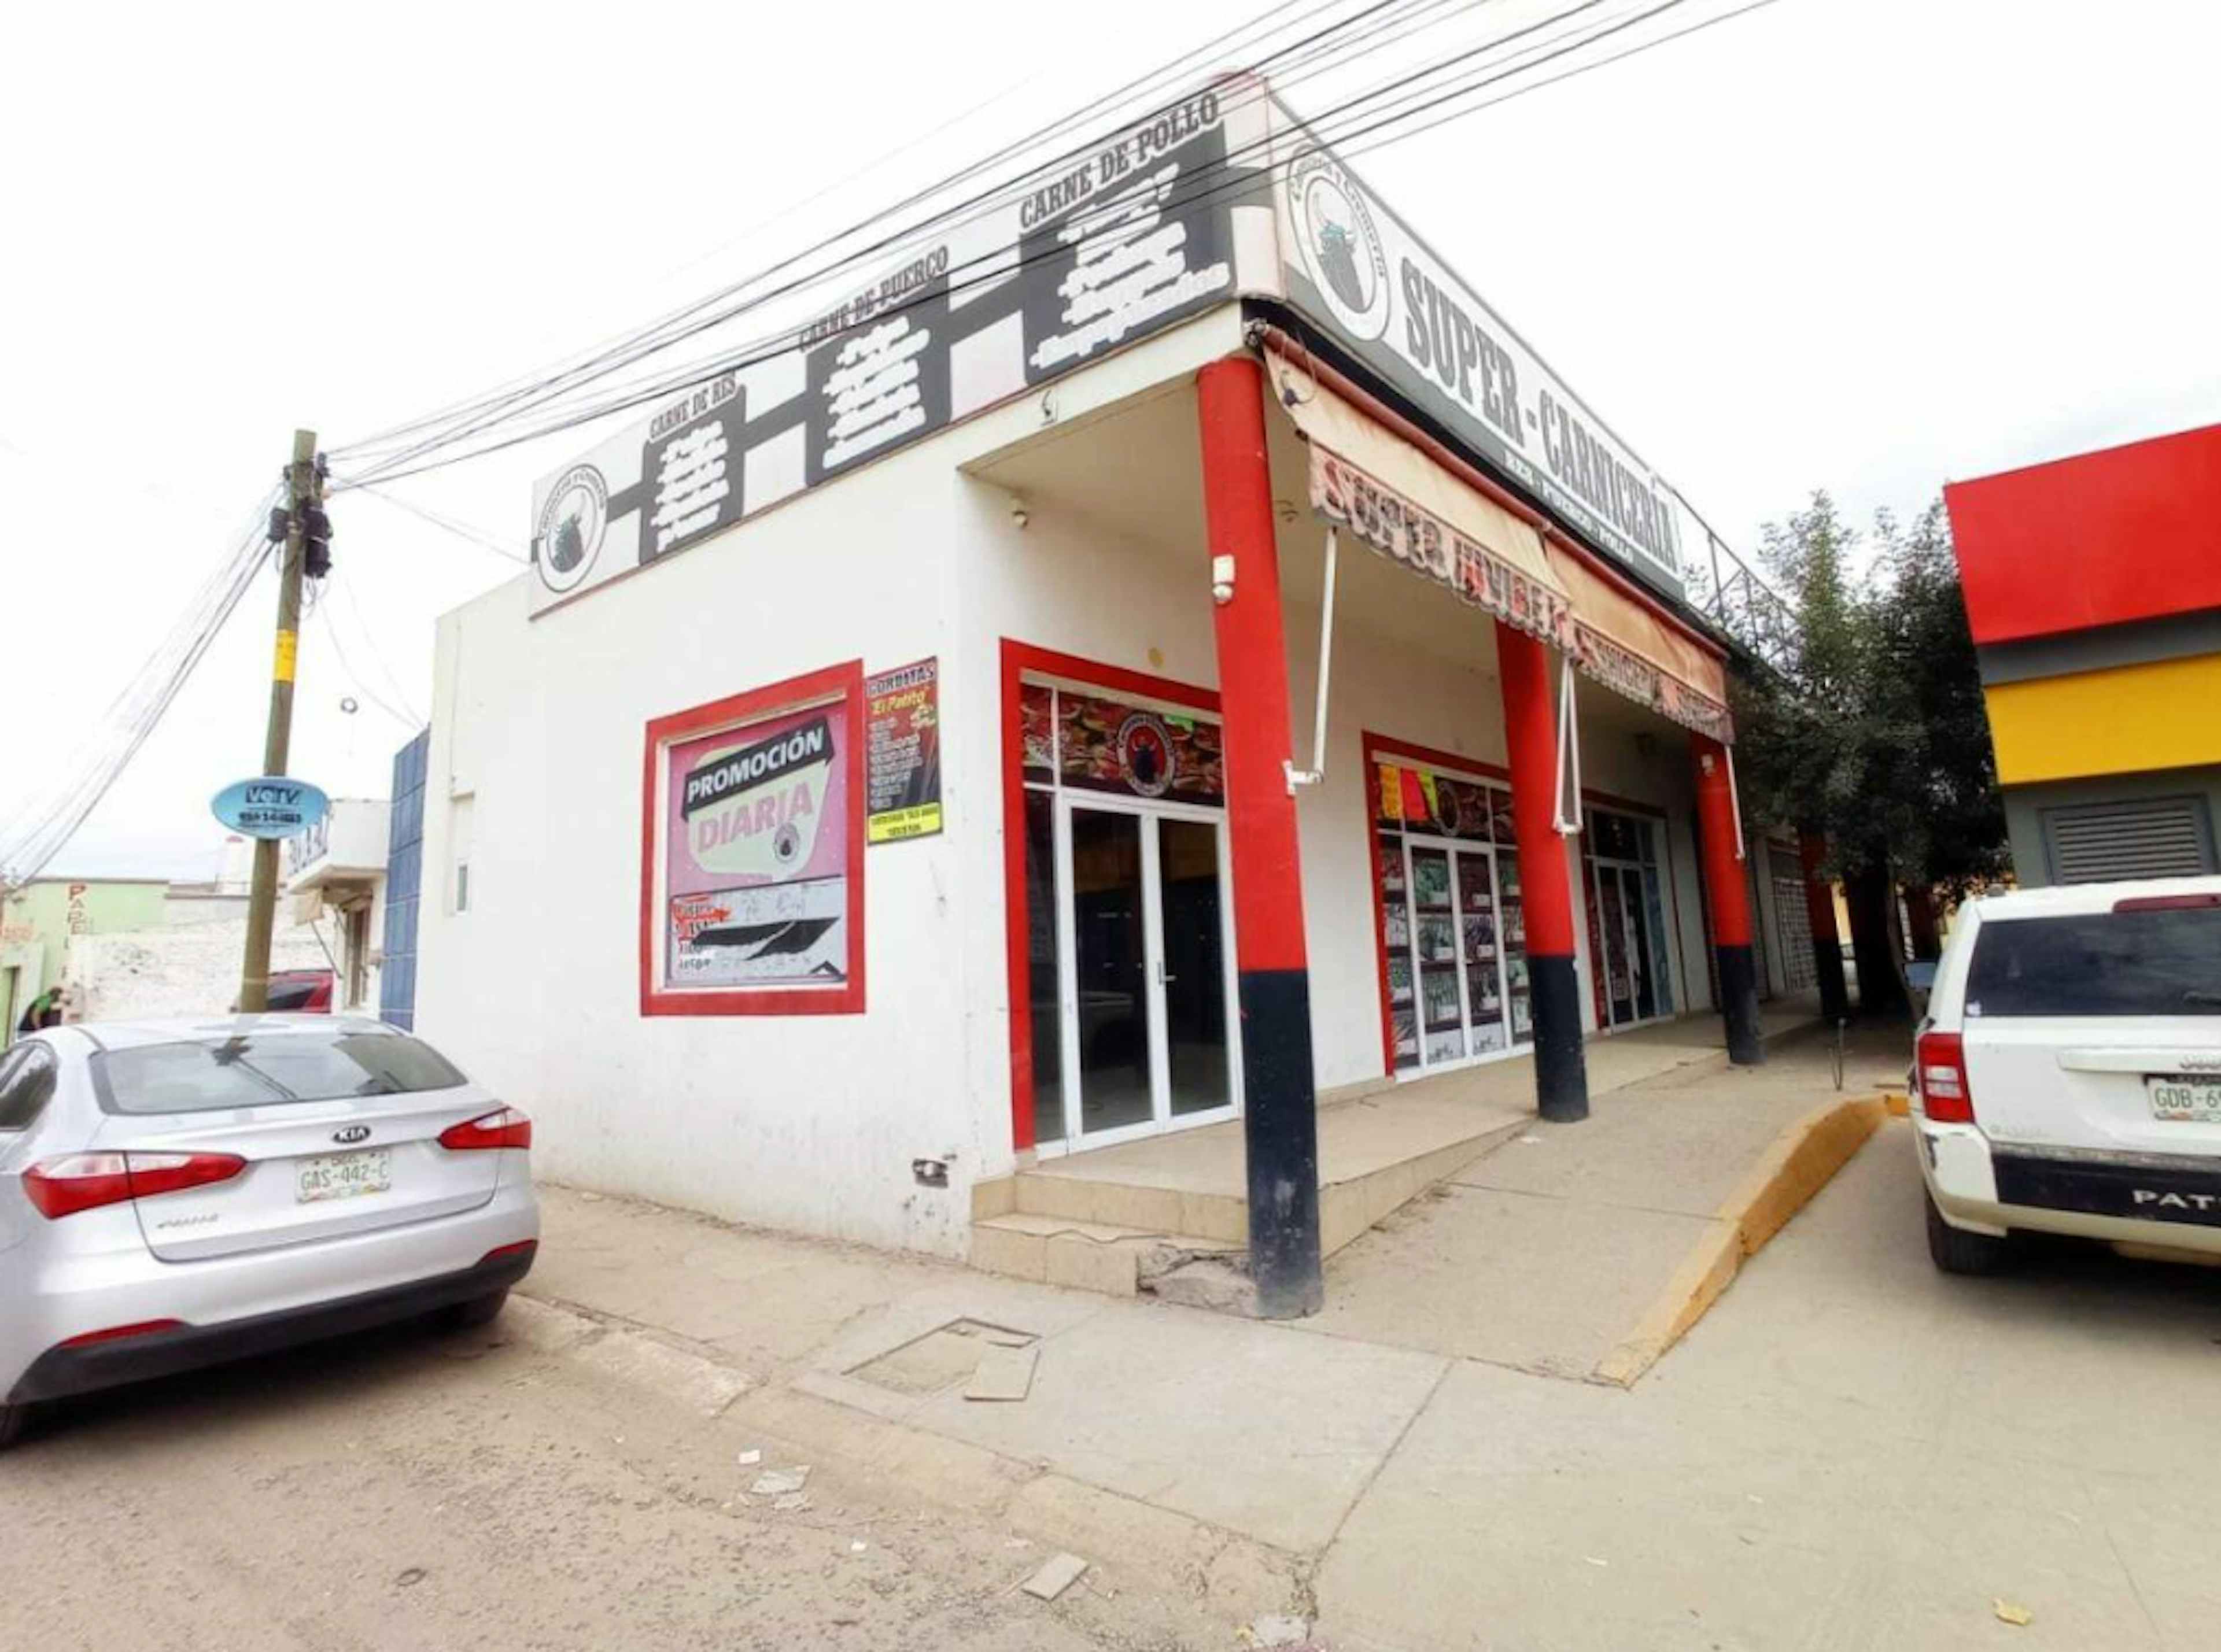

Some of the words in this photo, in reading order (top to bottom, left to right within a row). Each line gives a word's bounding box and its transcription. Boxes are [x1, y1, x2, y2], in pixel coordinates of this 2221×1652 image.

[1020, 162, 1092, 229] CARNE
[1100, 142, 1128, 184] DE
[1137, 93, 1219, 162] POLLO
[880, 245, 949, 307] PUERCO
[687, 725, 825, 803] PROMOCIÓN
[698, 781, 813, 854] DIARIA
[2154, 1088, 2221, 1108] GDB-6
[339, 1128, 366, 1141] KIA
[300, 1161, 388, 1191] GAS-442-C
[2133, 1189, 2221, 1210] PAT
